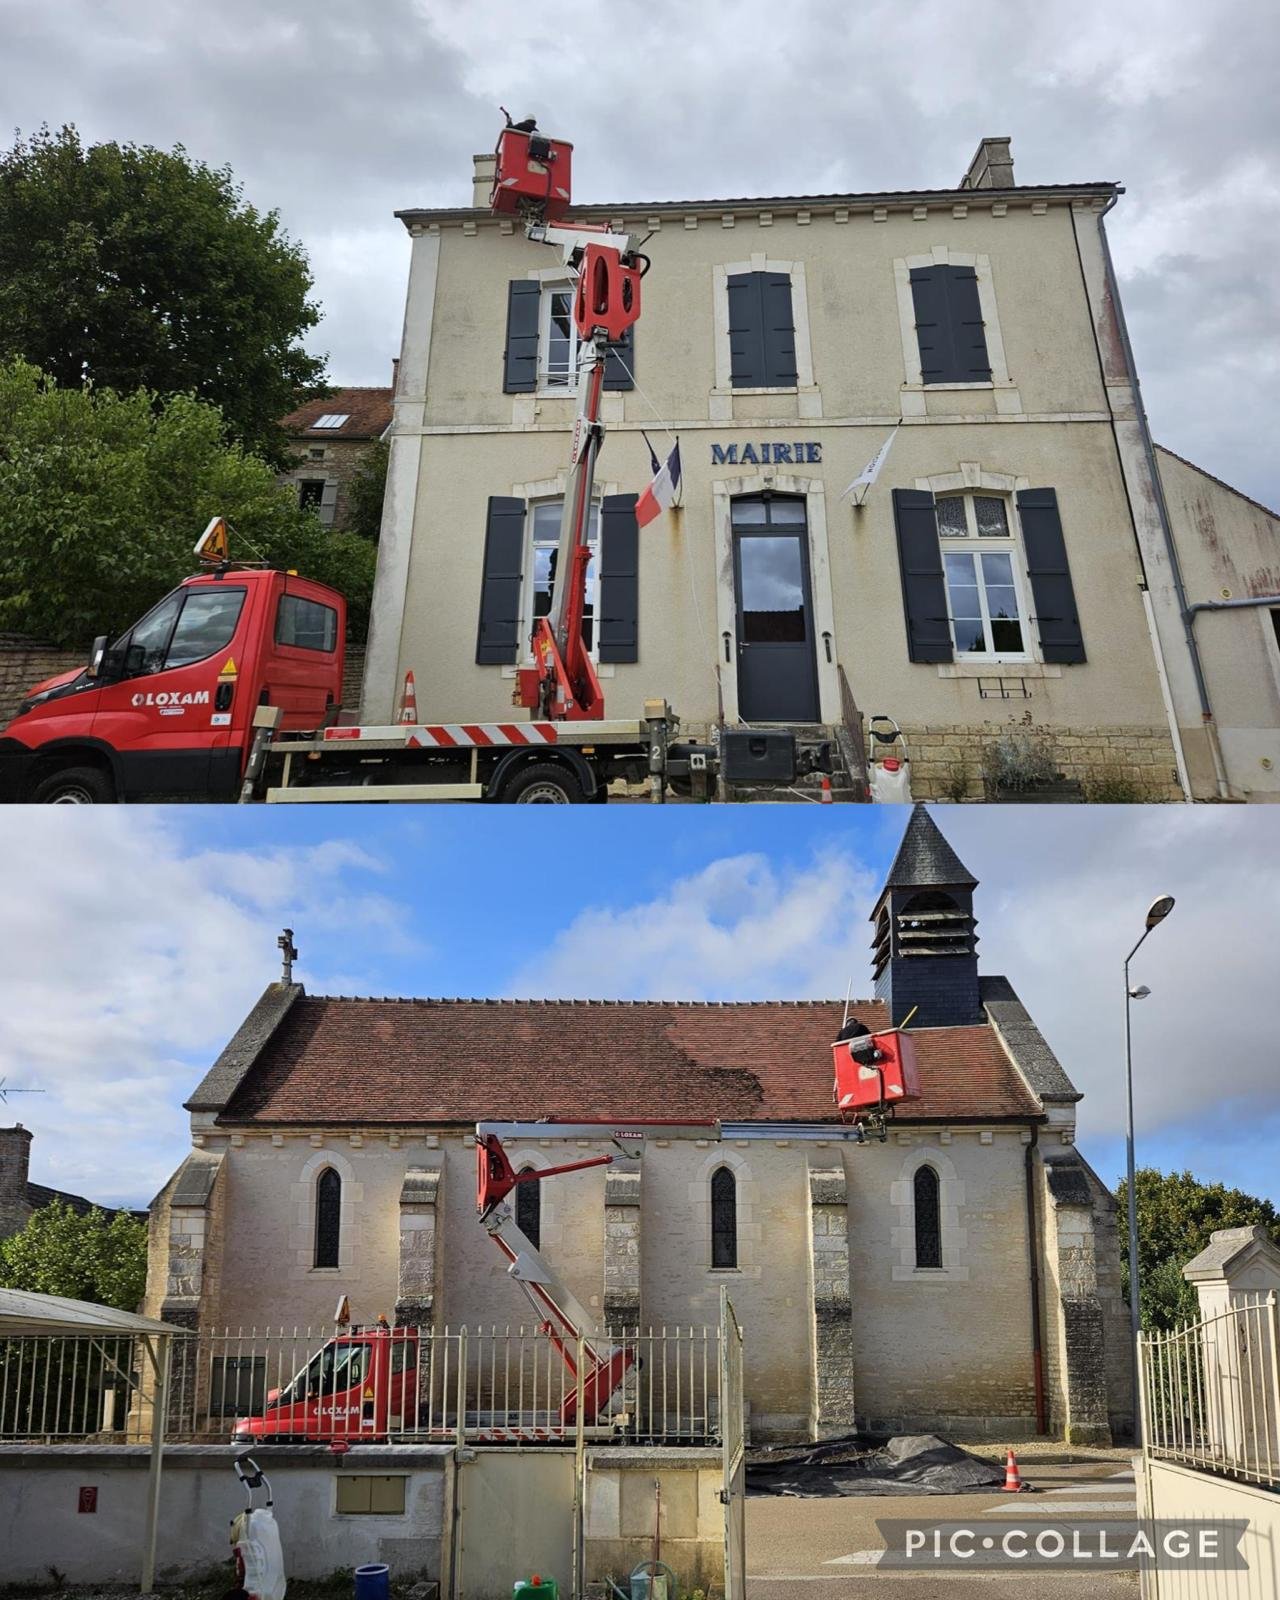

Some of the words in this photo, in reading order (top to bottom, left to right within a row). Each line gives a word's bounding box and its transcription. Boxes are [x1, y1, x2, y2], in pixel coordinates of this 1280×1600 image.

[711, 442, 822, 465] MAIRIE
[145, 691, 209, 706] LOXAM
[652, 746, 661, 760] 2
